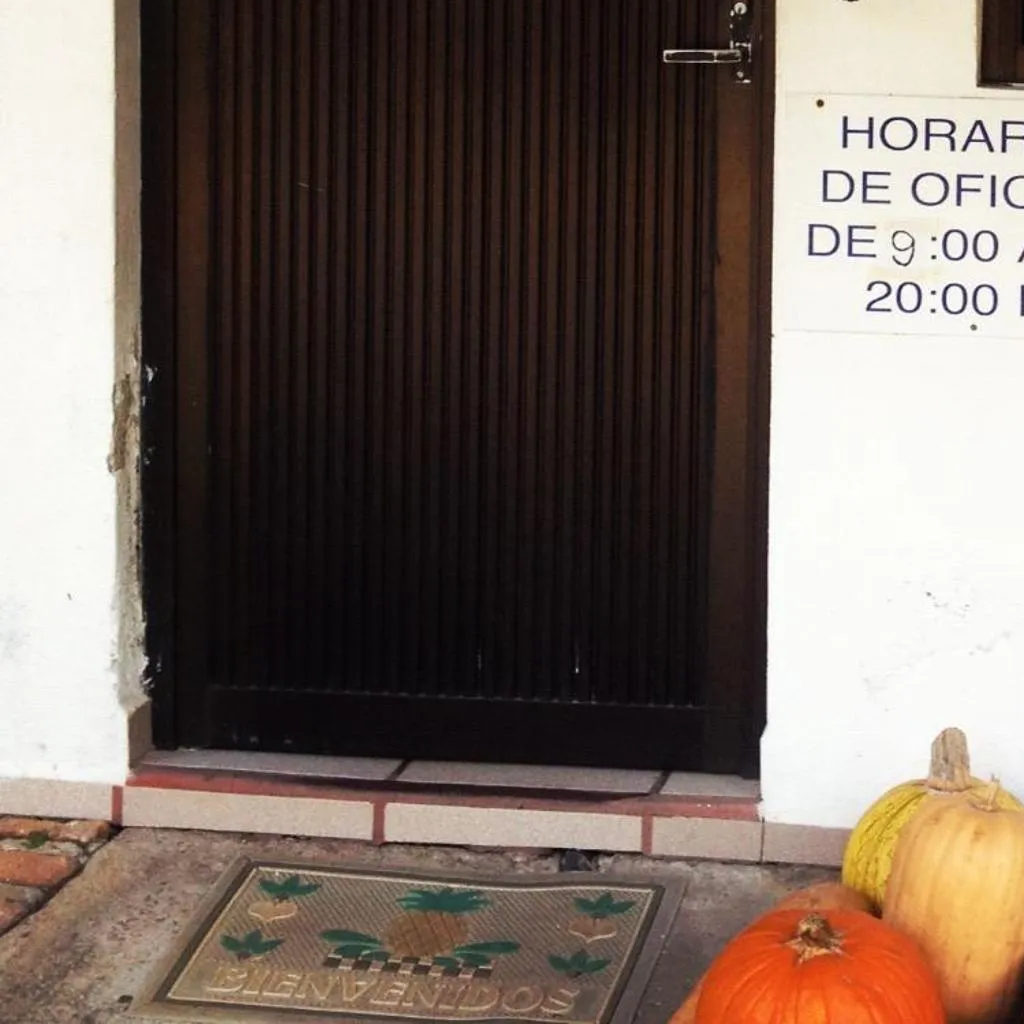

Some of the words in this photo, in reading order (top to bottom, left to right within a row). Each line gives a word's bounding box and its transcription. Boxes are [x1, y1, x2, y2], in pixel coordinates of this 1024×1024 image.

[821, 170, 892, 204] DE
[807, 224, 877, 258] DE
[865, 280, 999, 316] 20:00
[204, 966, 579, 1014] BIENVENIDOS
